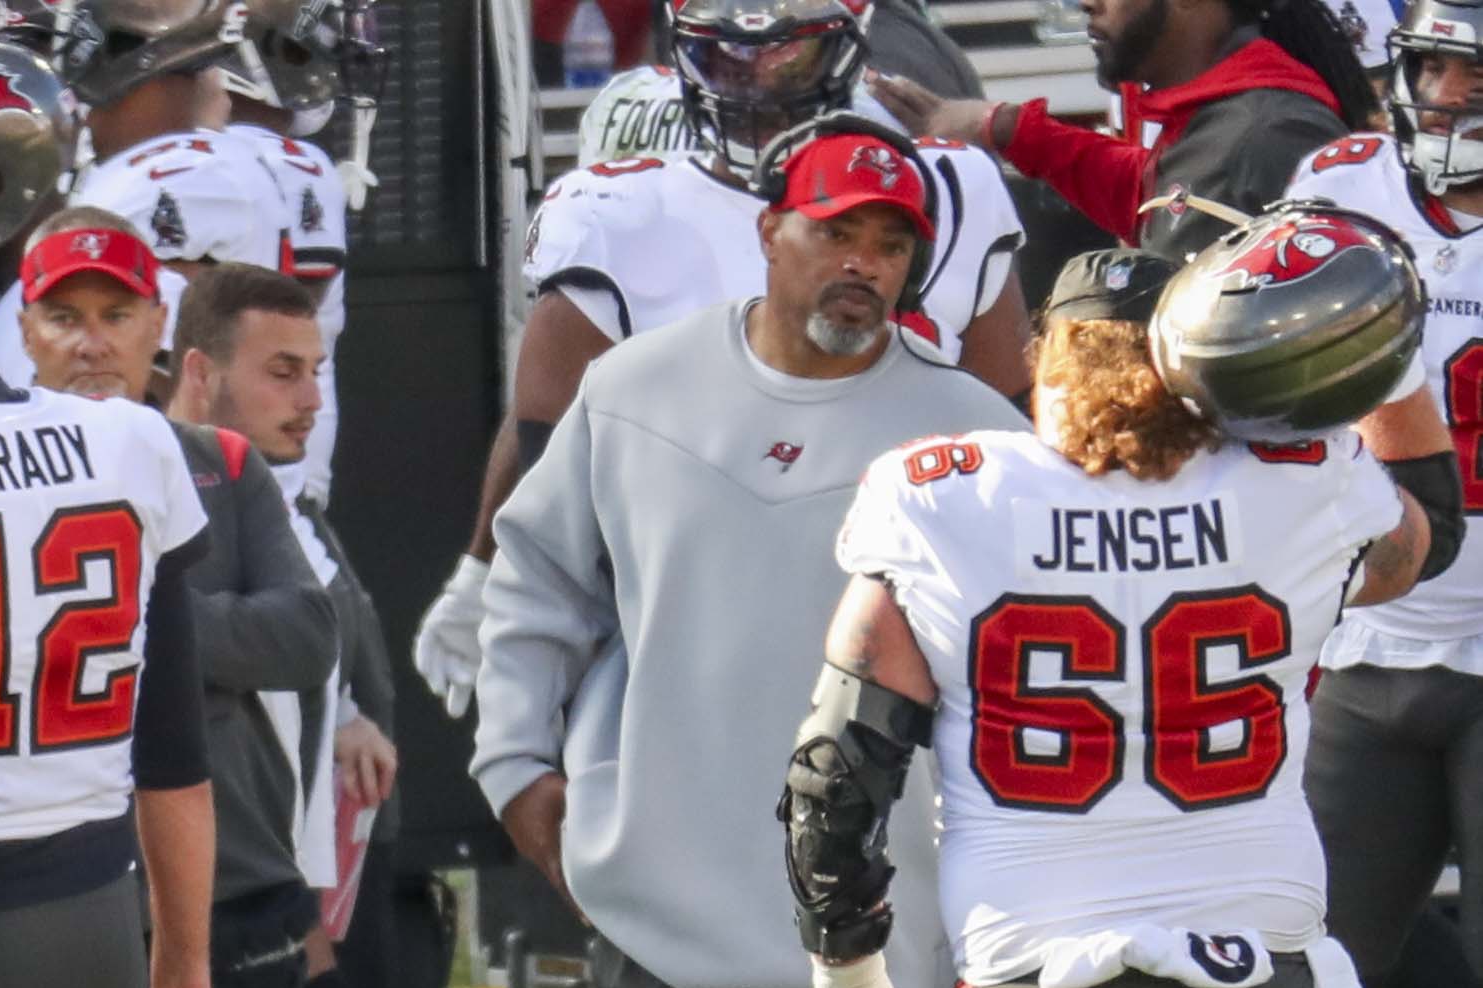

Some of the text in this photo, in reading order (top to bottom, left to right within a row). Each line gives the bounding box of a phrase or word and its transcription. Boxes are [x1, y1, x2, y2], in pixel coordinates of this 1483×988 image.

[600, 98, 696, 151] FOURN
[1032, 498, 1228, 572] JENSEN
[967, 582, 1292, 814] 66
